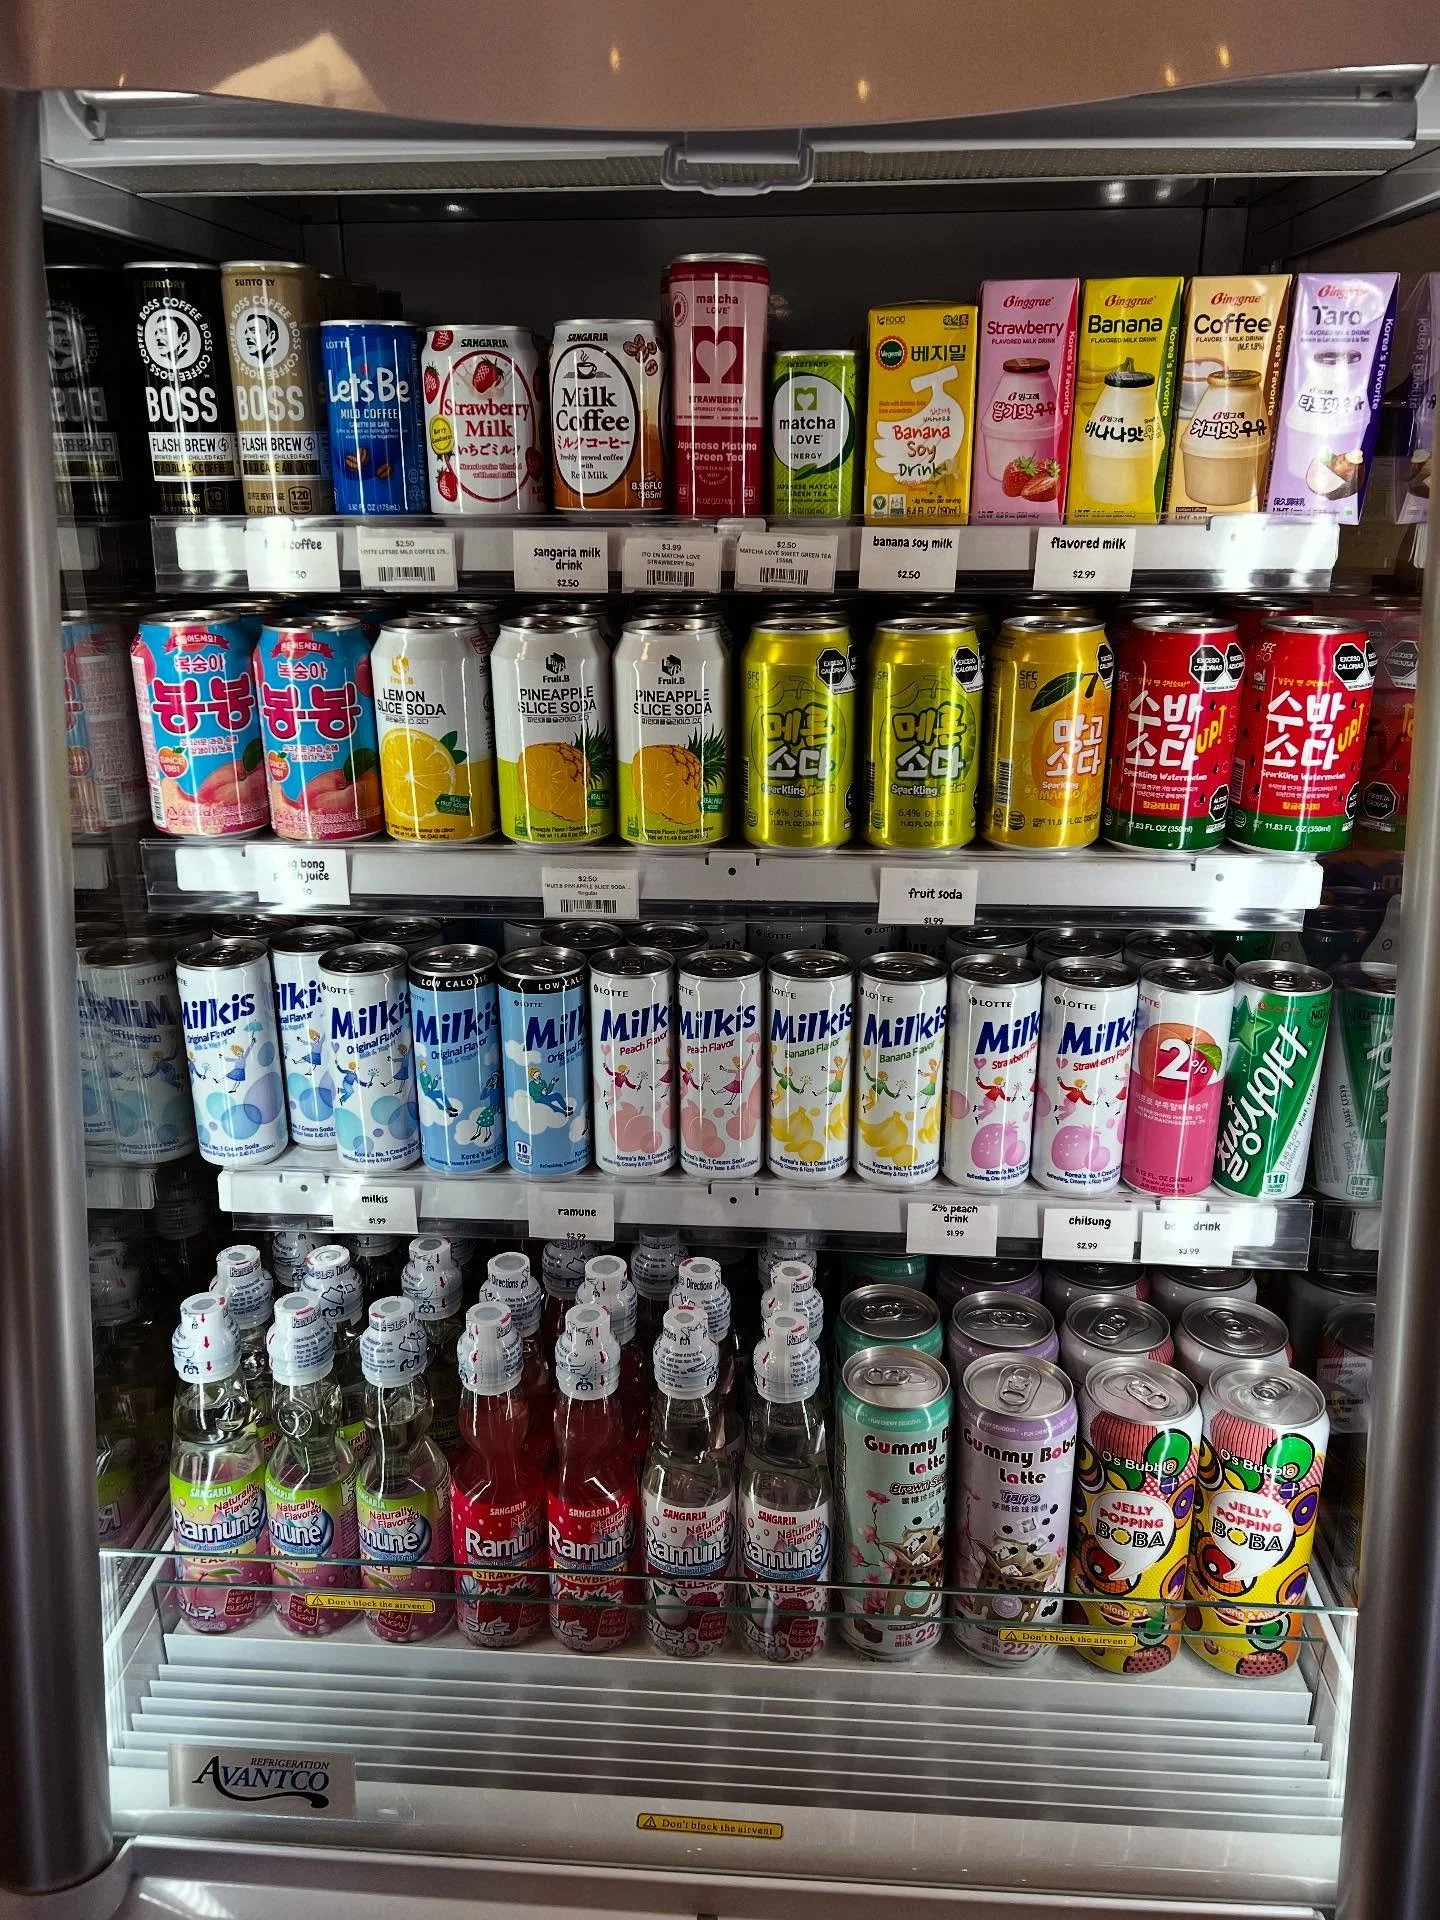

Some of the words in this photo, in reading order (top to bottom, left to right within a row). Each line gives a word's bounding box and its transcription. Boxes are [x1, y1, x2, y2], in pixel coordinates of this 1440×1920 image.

[696, 293, 739, 305] matcha
[1312, 305, 1362, 326] Taro
[987, 321, 1065, 337] Strawberry
[1088, 314, 1163, 334] Banana
[1194, 313, 1272, 334] Coffee
[460, 338, 509, 349] SANGARIA
[567, 332, 609, 343] SANGARIA
[911, 344, 967, 362] 베지밀
[376, 366, 411, 404] Be
[562, 386, 618, 407] Milk
[689, 396, 744, 404] STRAWBERRY
[145, 387, 217, 422] BOSS
[237, 387, 305, 422] BOSS
[445, 399, 531, 421] Strawberry
[364, 409, 400, 420] COFFEE
[556, 408, 630, 431] Coffee
[465, 420, 515, 438] Milk
[780, 416, 836, 430] matcha
[791, 435, 821, 445] LOVE
[893, 425, 952, 441] Banana
[185, 437, 216, 452] BREW
[271, 437, 302, 452] BREW
[907, 441, 937, 464] Soy
[588, 470, 608, 480] Milk
[899, 463, 943, 478] Drink
[396, 540, 414, 548] $2.50
[661, 543, 682, 551] $3.99
[776, 541, 797, 550] $2.50
[873, 536, 909, 548] banana
[911, 538, 929, 552] soy
[931, 538, 953, 549] milk
[1051, 537, 1099, 550] flavored
[1102, 538, 1127, 550] milk
[534, 546, 577, 561] sangaria
[579, 546, 601, 558] milk
[740, 548, 764, 556] MATCHA
[556, 559, 583, 571] drink
[647, 559, 684, 567] STRAWBERRY
[897, 569, 920, 580] $2.50
[1073, 570, 1095, 579] $2.99
[557, 579, 580, 588] $2.50
[175, 654, 225, 674] 복숭아
[279, 663, 327, 681] 복숭아
[543, 675, 570, 683] Fruit.B
[1020, 671, 1039, 680] SFC
[658, 676, 685, 685] Fruit.B
[384, 688, 426, 703] LEMON
[520, 686, 594, 701] PINEAPPLE
[636, 689, 710, 702] PINEAPPLE
[378, 699, 403, 715] SLICE
[407, 702, 447, 716] SODA
[518, 701, 558, 715] SLICE
[561, 699, 597, 714] SODA
[634, 702, 671, 717] SLICE
[674, 701, 712, 716] SODA
[1128, 689, 1205, 739] 수박
[1266, 690, 1346, 738] 수박
[1125, 733, 1199, 772] 소다
[1263, 734, 1340, 771] 소다
[766, 746, 836, 780] 소다
[896, 745, 966, 779] 소다
[1046, 747, 1102, 778] 소다
[1123, 767, 1158, 781] Sparkling
[1159, 769, 1207, 782] Watermelon
[1261, 769, 1299, 781] Sparkling
[891, 783, 938, 797] Sparkling
[1043, 781, 1080, 790] Sparkling
[1145, 822, 1154, 832] FL
[1285, 823, 1294, 832] FL
[300, 859, 325, 872] bong
[304, 871, 330, 883] juice
[578, 875, 598, 883] $2.50
[908, 889, 936, 900] fruit
[938, 889, 963, 900] soda
[924, 917, 944, 926] $1.99
[421, 978, 441, 988] LOW
[539, 981, 560, 991] LOW
[600, 988, 629, 998] LOTTE
[979, 1000, 1012, 1008] LOTTE
[679, 1004, 756, 1043] Milkis
[771, 1003, 854, 1044] Milkis
[863, 1004, 948, 1049] Milkis
[620, 1041, 645, 1056] Peach
[708, 1039, 735, 1054] Flavor
[880, 1051, 911, 1064] Banana
[517, 1142, 527, 1154] 10
[361, 1194, 389, 1204] milkis
[557, 1207, 597, 1218] ramune
[931, 1203, 948, 1214] 2%
[950, 1204, 978, 1216] peach
[368, 1217, 386, 1226] $1.99
[943, 1213, 969, 1224] drink
[1068, 1215, 1112, 1230] chilsung
[1193, 1220, 1221, 1232] drink
[566, 1231, 587, 1240] $2.99
[946, 1229, 965, 1238] $1.99
[1076, 1241, 1098, 1251] $2.99
[863, 1435, 938, 1457] Gummy
[963, 1428, 1034, 1468] Gummy
[1040, 1435, 1076, 1462] Boba
[1125, 1459, 1175, 1474] Bubble
[1219, 1448, 1240, 1466] O's
[1243, 1458, 1296, 1477] Bubble
[189, 1485, 233, 1499] SANGARIA
[890, 1482, 931, 1496] Brown
[1001, 1491, 1041, 1505] Taro
[277, 1499, 317, 1514] Naturally
[284, 1505, 323, 1521] Flavored
[369, 1505, 415, 1520] Naturally
[489, 1500, 528, 1516] SANGARIA
[569, 1508, 611, 1519] SANGARIA
[1111, 1501, 1155, 1517] JELLY
[1227, 1501, 1272, 1519] JELLY
[378, 1512, 420, 1530] Flavored
[662, 1508, 708, 1522] SANGARIA
[758, 1510, 798, 1526] SANGARIA
[1099, 1507, 1164, 1530] POPPING
[1215, 1506, 1283, 1534] POPPING
[778, 1518, 822, 1540] Naturally
[327, 1598, 352, 1609] Don't
[352, 1599, 378, 1609] block
[379, 1601, 393, 1609] the
[394, 1601, 426, 1611] airvent
[1022, 1632, 1049, 1642] Don't
[1050, 1634, 1075, 1643] block
[1077, 1635, 1091, 1644] the
[1093, 1637, 1127, 1646] airvent
[250, 1756, 330, 1771] REFRIGERATION
[191, 1755, 330, 1807] AVANTCO
[662, 1818, 689, 1828] Don't
[691, 1821, 718, 1831] block
[719, 1824, 736, 1833] the
[738, 1826, 773, 1836] airvent
